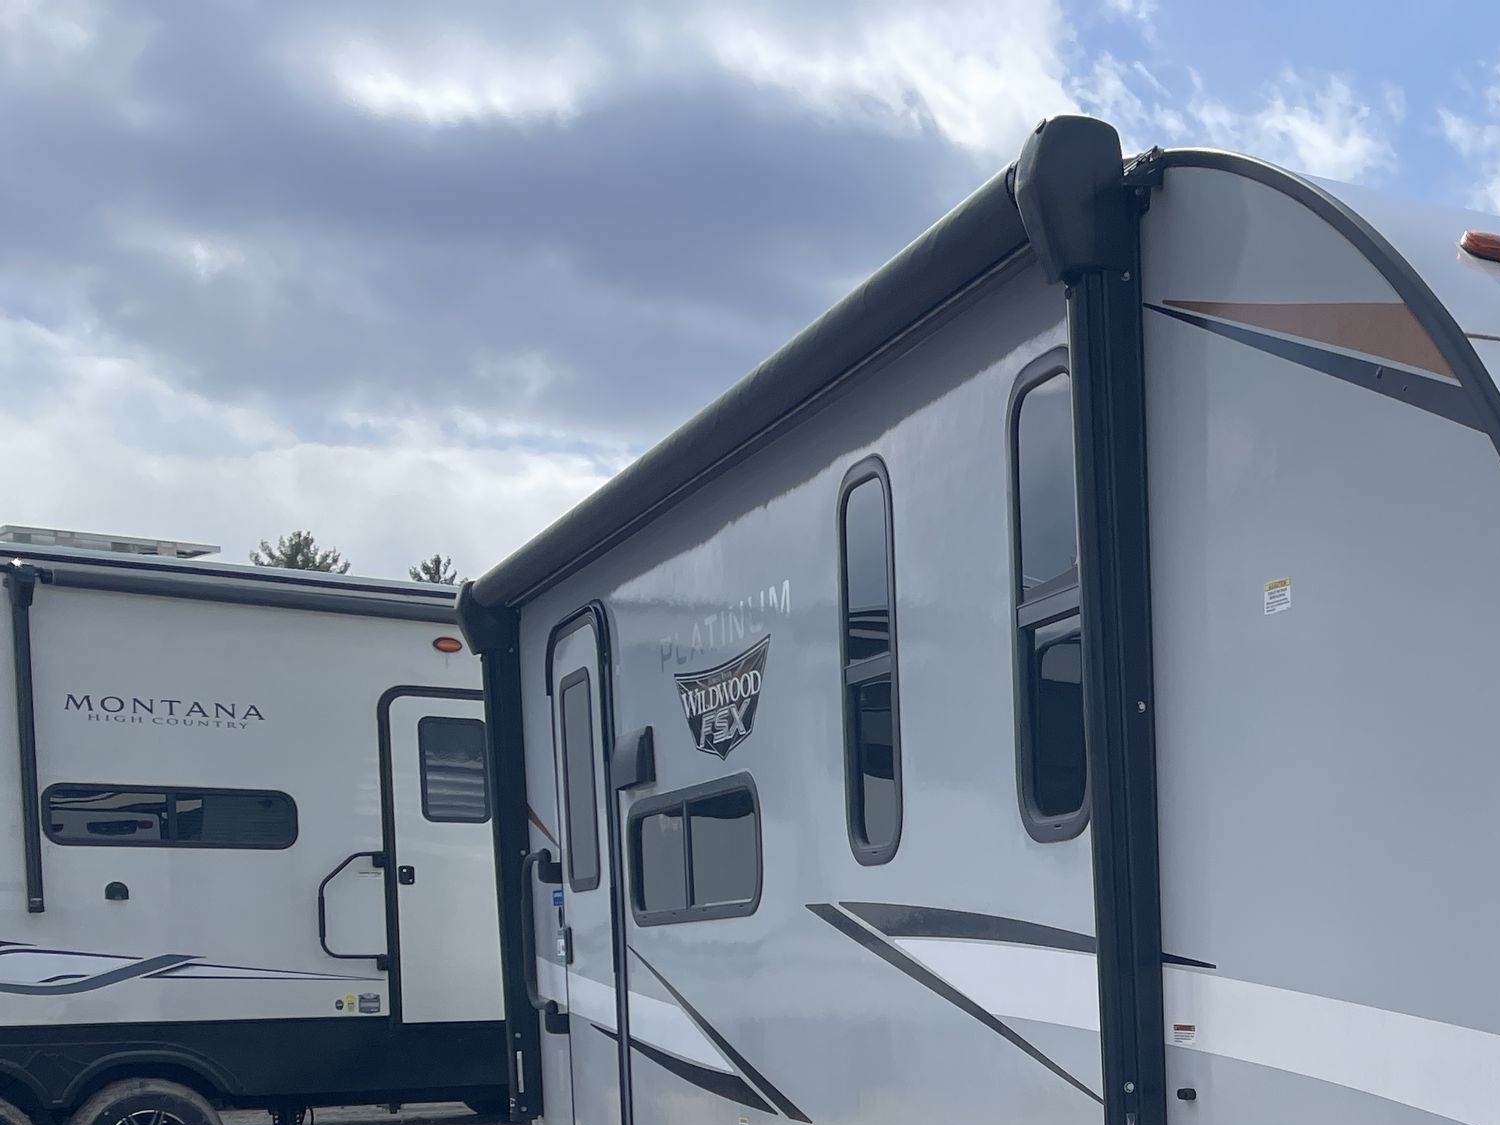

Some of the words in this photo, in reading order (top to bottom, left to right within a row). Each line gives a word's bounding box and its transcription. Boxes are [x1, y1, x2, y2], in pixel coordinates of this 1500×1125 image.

[64, 693, 266, 721] MONTANA
[681, 670, 762, 719] WILDWOOD
[88, 713, 143, 724] HIGH
[152, 717, 248, 730] COUNTRY
[699, 698, 751, 749] FSX
